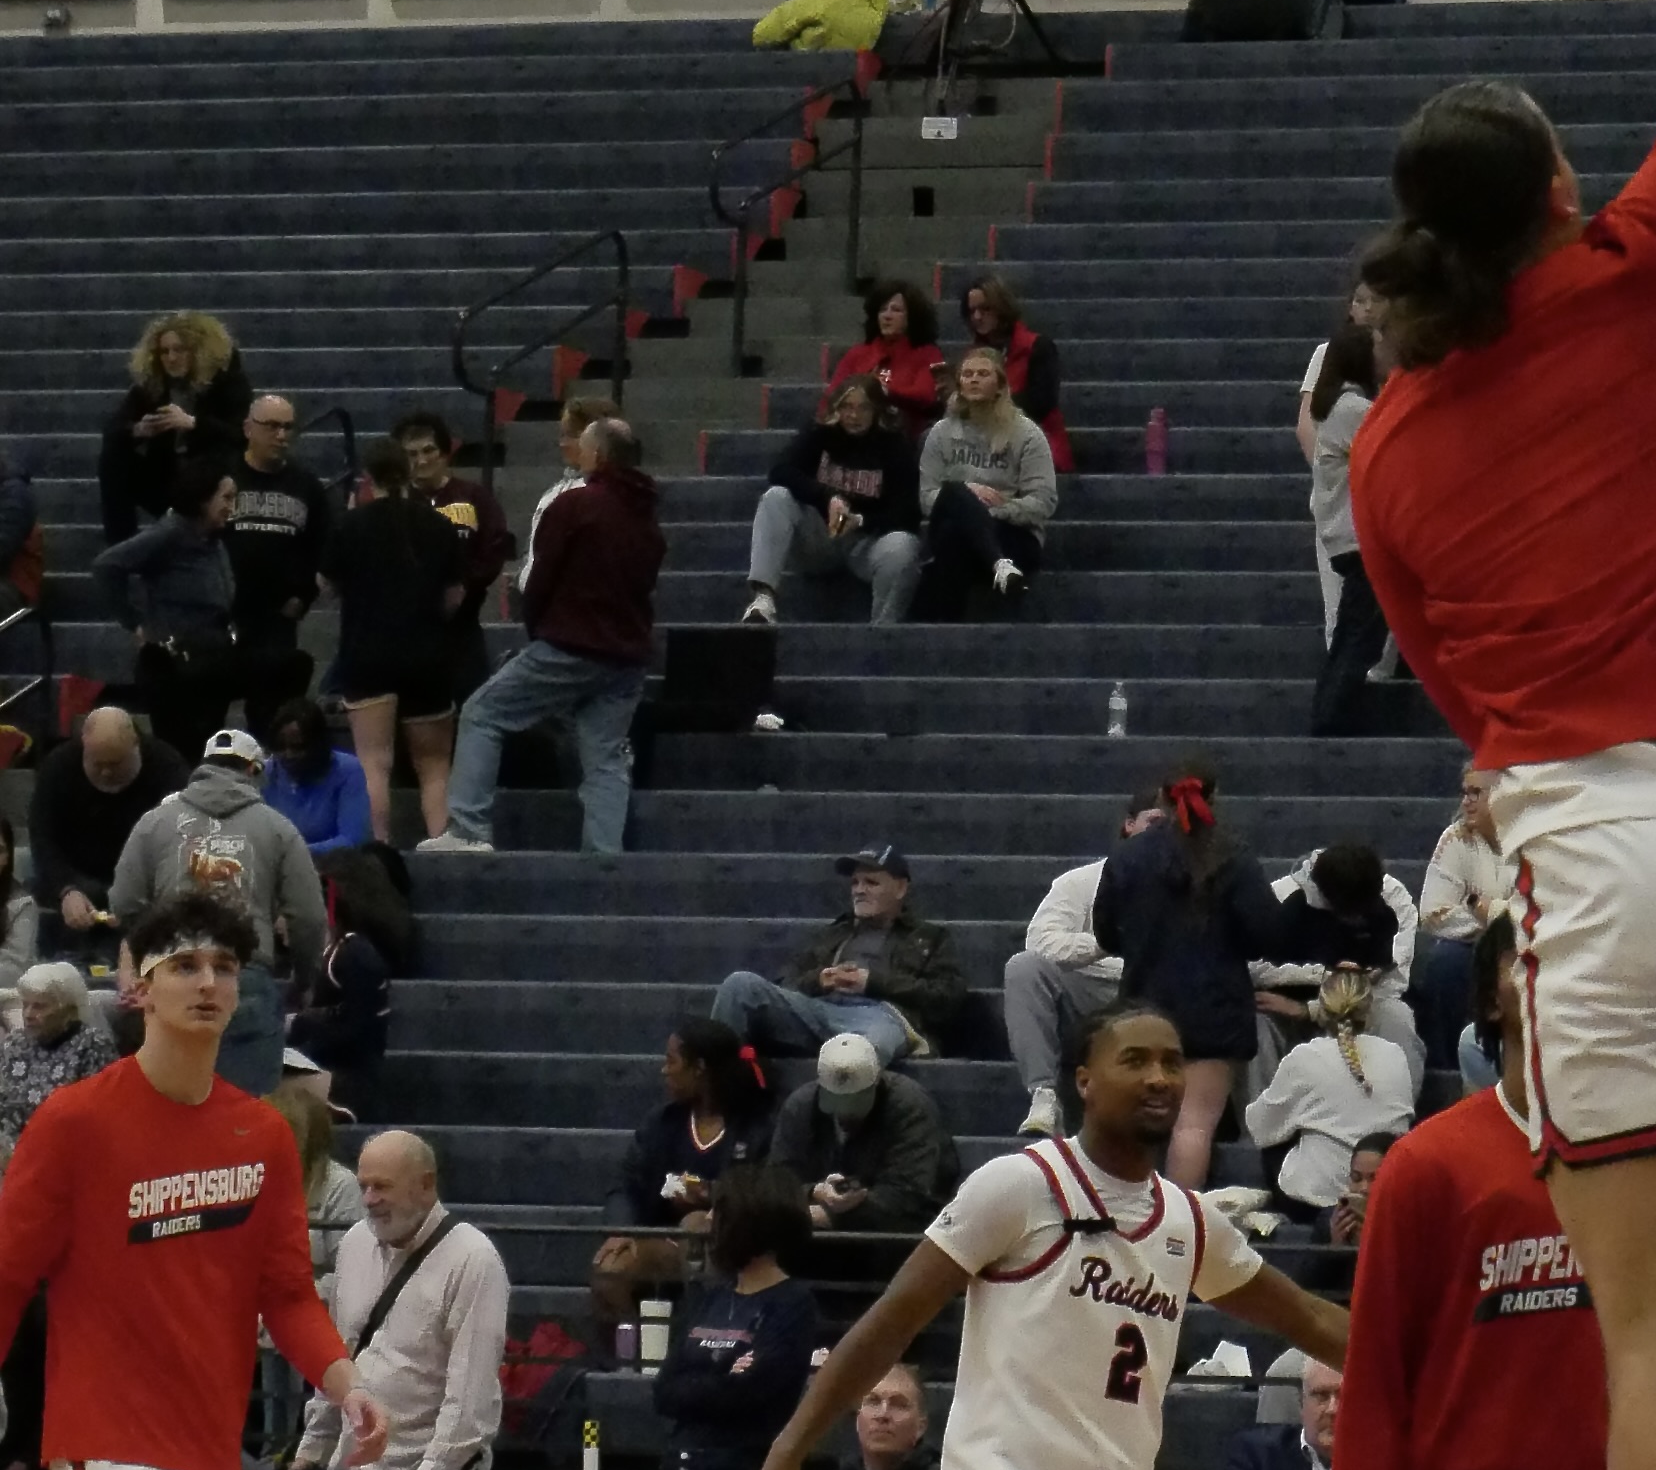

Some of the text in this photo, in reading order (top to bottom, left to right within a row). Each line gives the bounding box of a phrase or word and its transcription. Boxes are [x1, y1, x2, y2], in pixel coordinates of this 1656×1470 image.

[128, 1163, 266, 1219] SHIPPENSBURG
[152, 1214, 201, 1239] RAIDERS
[1069, 1256, 1180, 1322] Raiders
[1499, 1286, 1579, 1314] RAIDERS
[1104, 1320, 1148, 1405] 2
